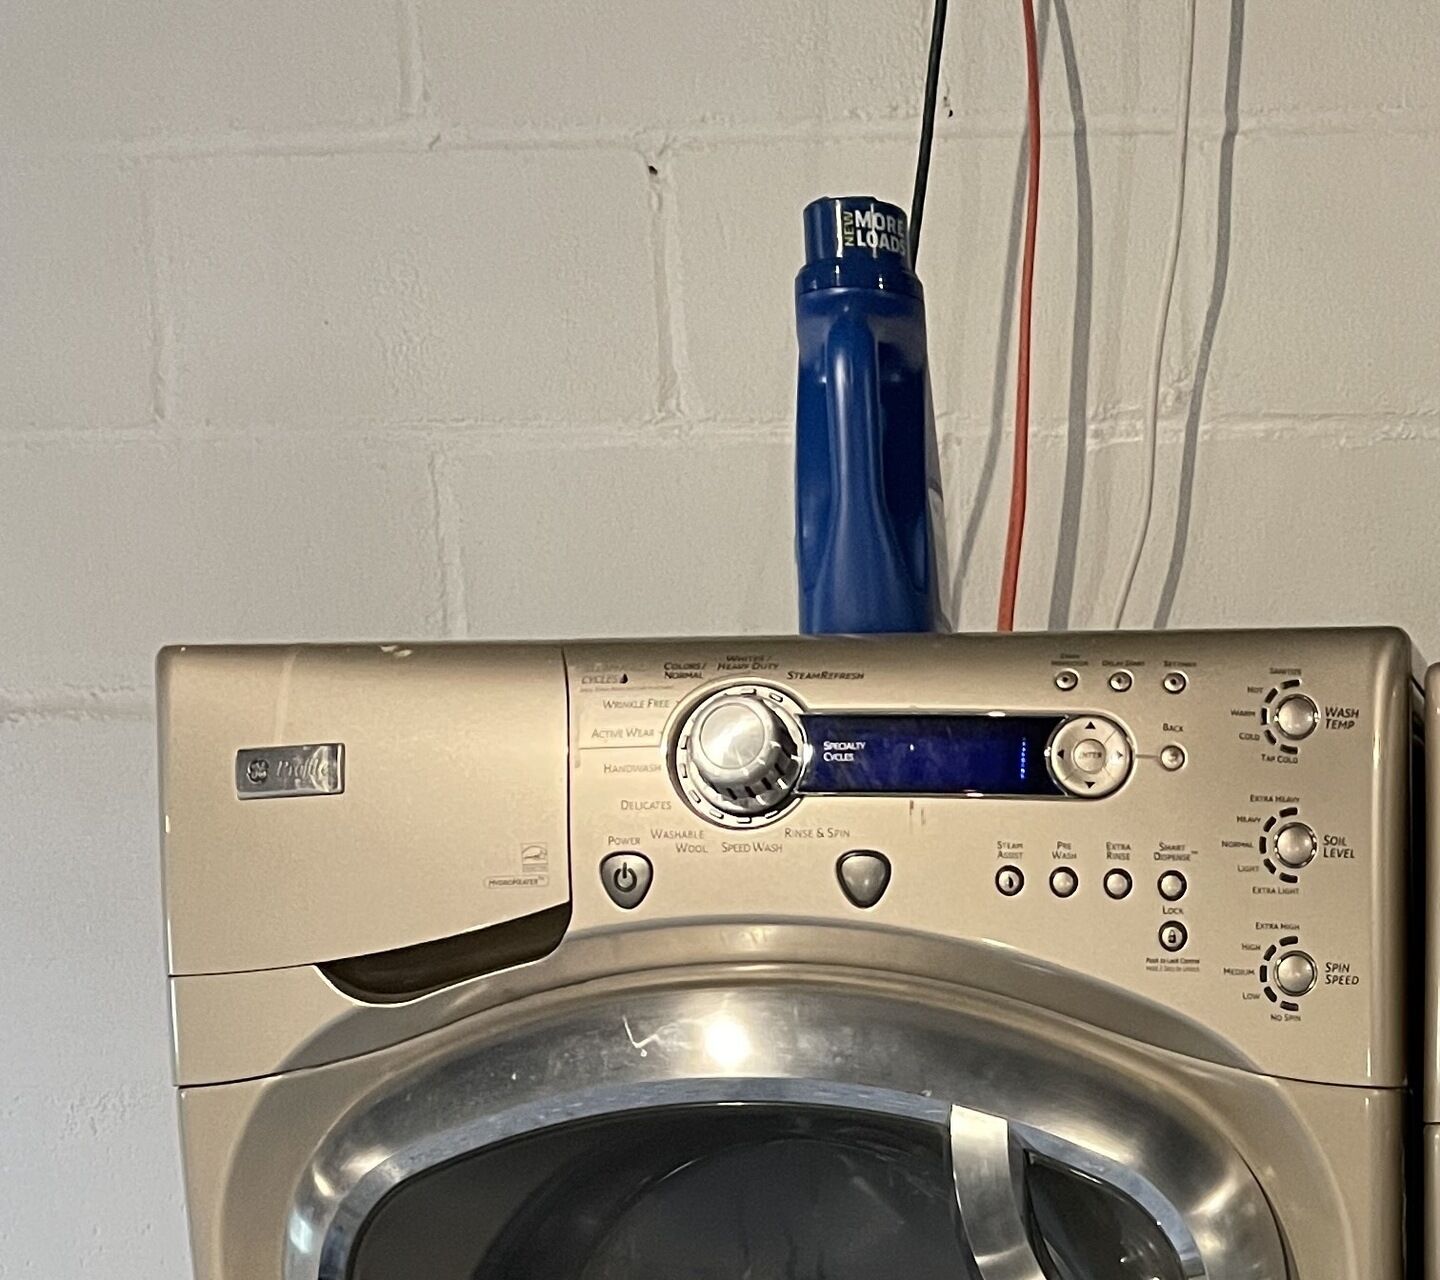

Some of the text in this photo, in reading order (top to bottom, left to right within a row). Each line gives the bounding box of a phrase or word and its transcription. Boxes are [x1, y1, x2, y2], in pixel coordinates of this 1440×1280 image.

[855, 210, 904, 237] MORE
[844, 211, 854, 246] NEW
[856, 230, 905, 256] LOADS
[717, 662, 779, 671] HEAVY DUTY
[664, 671, 703, 680] NORMAL
[1247, 686, 1264, 694] HOT
[602, 698, 670, 709] WRINKLE FREE
[1230, 709, 1256, 717] WARM
[1325, 706, 1359, 718] WASH
[1162, 723, 1184, 732] BACK
[1325, 719, 1355, 729] TEMP
[591, 727, 655, 739] ACTIVE WEAR
[1239, 733, 1260, 741] COLD
[823, 741, 866, 750] SPECIALTY
[823, 752, 854, 762] CYCLES
[1261, 754, 1298, 764] TAP COLD
[603, 763, 661, 774] HANDWASH
[1250, 794, 1300, 803] EXTRA HEAVY
[620, 800, 672, 811] DELICATES
[650, 829, 704, 839] WASHABLE
[784, 828, 850, 839] RINSE & SPIN
[607, 836, 641, 846] POWER
[997, 840, 1023, 849] STEAM
[1221, 840, 1254, 848] NORMAL
[1323, 834, 1347, 846] SOIL
[676, 842, 708, 854] WOOL
[722, 842, 782, 854] SPEED WASH
[1057, 841, 1072, 850] PRE
[1106, 841, 1131, 851] EXTRA
[1159, 842, 1185, 851] SMART
[997, 851, 1023, 860] ASSIST
[1052, 851, 1077, 860] WASH
[1106, 851, 1130, 860] RINSE
[1324, 849, 1355, 859] LEVEL
[1237, 865, 1259, 873] LIGHT
[1252, 886, 1300, 895] EXTRA LIGHT
[1162, 905, 1184, 915] LOCK
[1255, 922, 1300, 930] EXTRA HIGH
[1241, 943, 1261, 951] HIGH
[1223, 967, 1255, 975] MEDIUM
[1325, 962, 1350, 973] SPIN
[1325, 974, 1359, 985] SPEED
[1242, 992, 1260, 1000] LOW
[1270, 1013, 1301, 1022] NO SPIN
